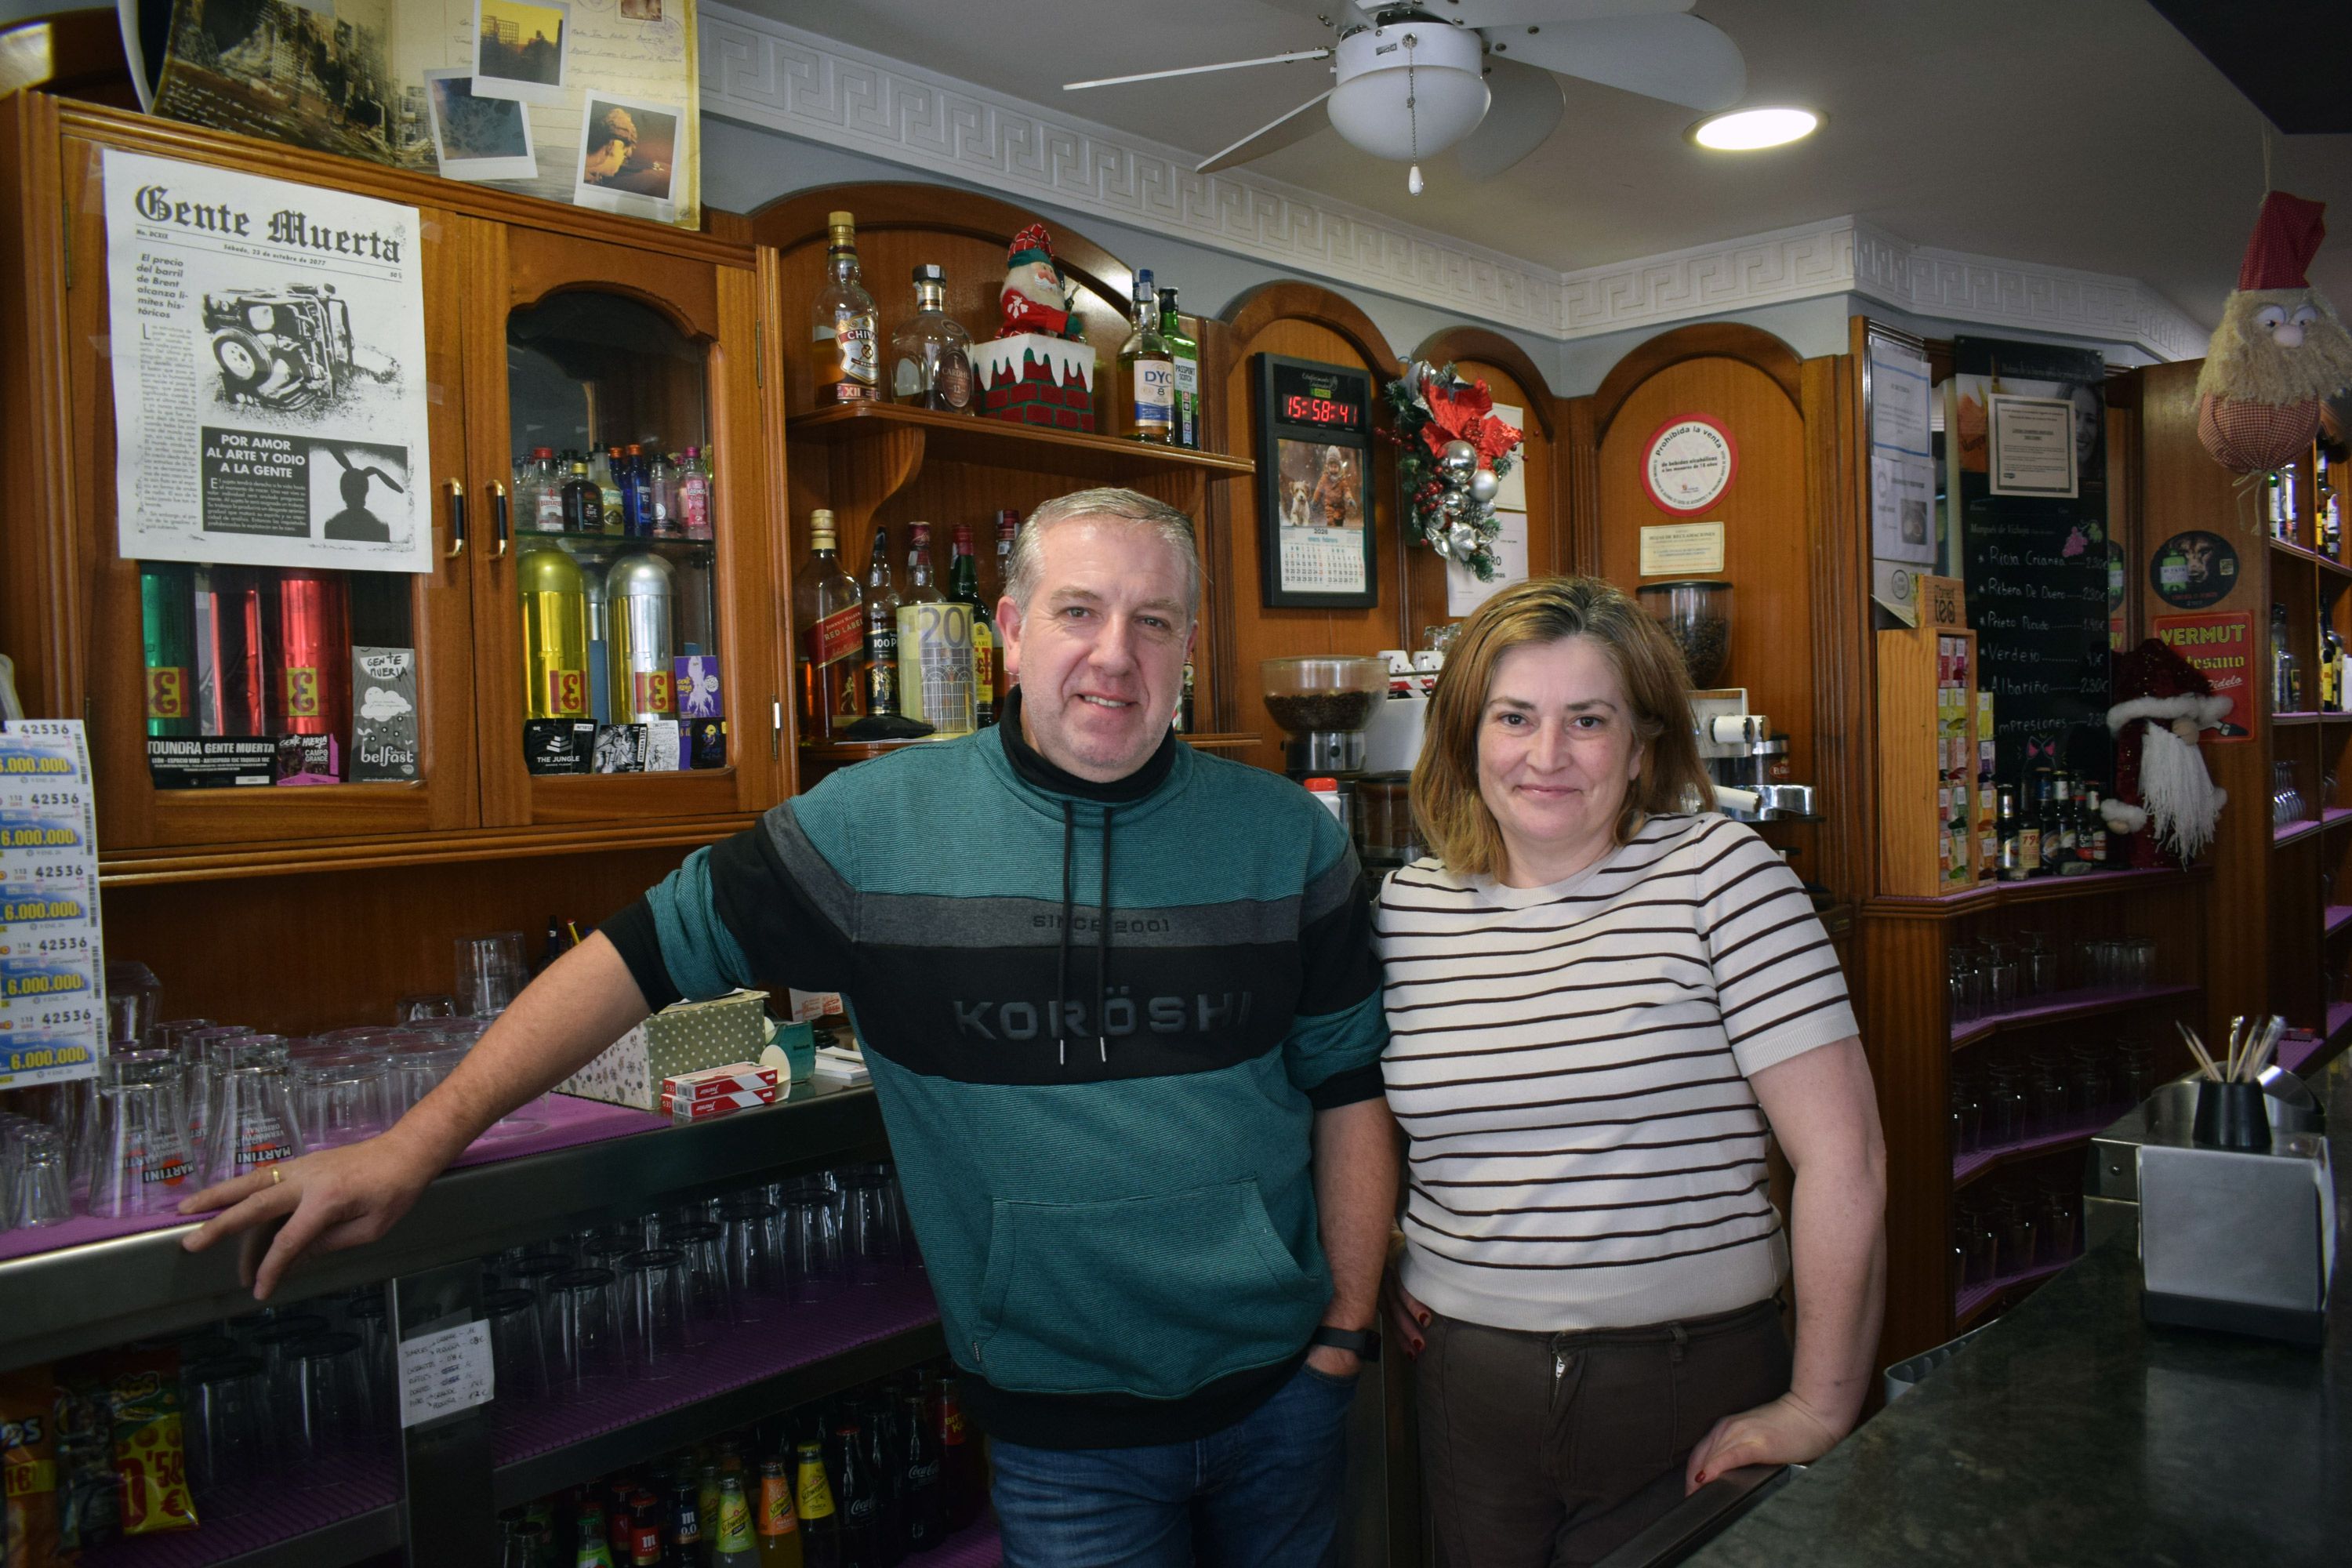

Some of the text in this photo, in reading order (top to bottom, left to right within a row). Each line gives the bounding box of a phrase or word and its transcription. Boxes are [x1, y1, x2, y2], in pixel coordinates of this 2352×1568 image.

[135, 185, 401, 264] Gente Muerta
[141, 252, 183, 267] El precio
[136, 264, 183, 278] del barril
[136, 274, 180, 289] de Brent
[136, 286, 176, 298] alcanza
[138, 297, 185, 310] mites his-
[137, 307, 171, 319] tóricos
[1144, 370, 1172, 385] DYC
[844, 387, 862, 397] XII
[953, 384, 962, 394] 12
[1156, 388, 1166, 397] 8
[220, 434, 292, 451] POR AMOR
[1655, 426, 1690, 456] Prohibida
[1703, 429, 1722, 448] venta
[206, 447, 306, 466] AL ARTE Y ODIO
[1689, 456, 1718, 464] alcohólicas
[220, 462, 292, 478] A LA GENTE
[1989, 546, 2020, 565] Rioja
[1988, 577, 2023, 597] Ribera
[2025, 583, 2038, 598] De
[2041, 585, 2067, 599] Duero
[1987, 610, 2017, 628] Prieto
[824, 618, 863, 641] RED LABEL
[2159, 623, 2246, 646] VERMUT
[873, 637, 890, 648] 100
[367, 652, 402, 666] GENTE
[2185, 655, 2246, 670] tesano
[1991, 675, 2050, 696] Albariño
[20, 724, 70, 735] 42536
[1998, 717, 2067, 735] mpresiones
[204, 743, 235, 754] GENTE
[236, 742, 276, 753] MUERTA
[361, 746, 414, 768] belfast
[31, 793, 79, 804] 42536
[35, 865, 84, 878] 42536
[1115, 918, 1171, 934] 2001
[39, 937, 87, 951] 42536
[42, 1009, 92, 1025] 42536
[952, 985, 1253, 1041] KORÖSHI
[237, 1145, 292, 1163] MARTINI
[143, 1160, 194, 1182] MARTINI
